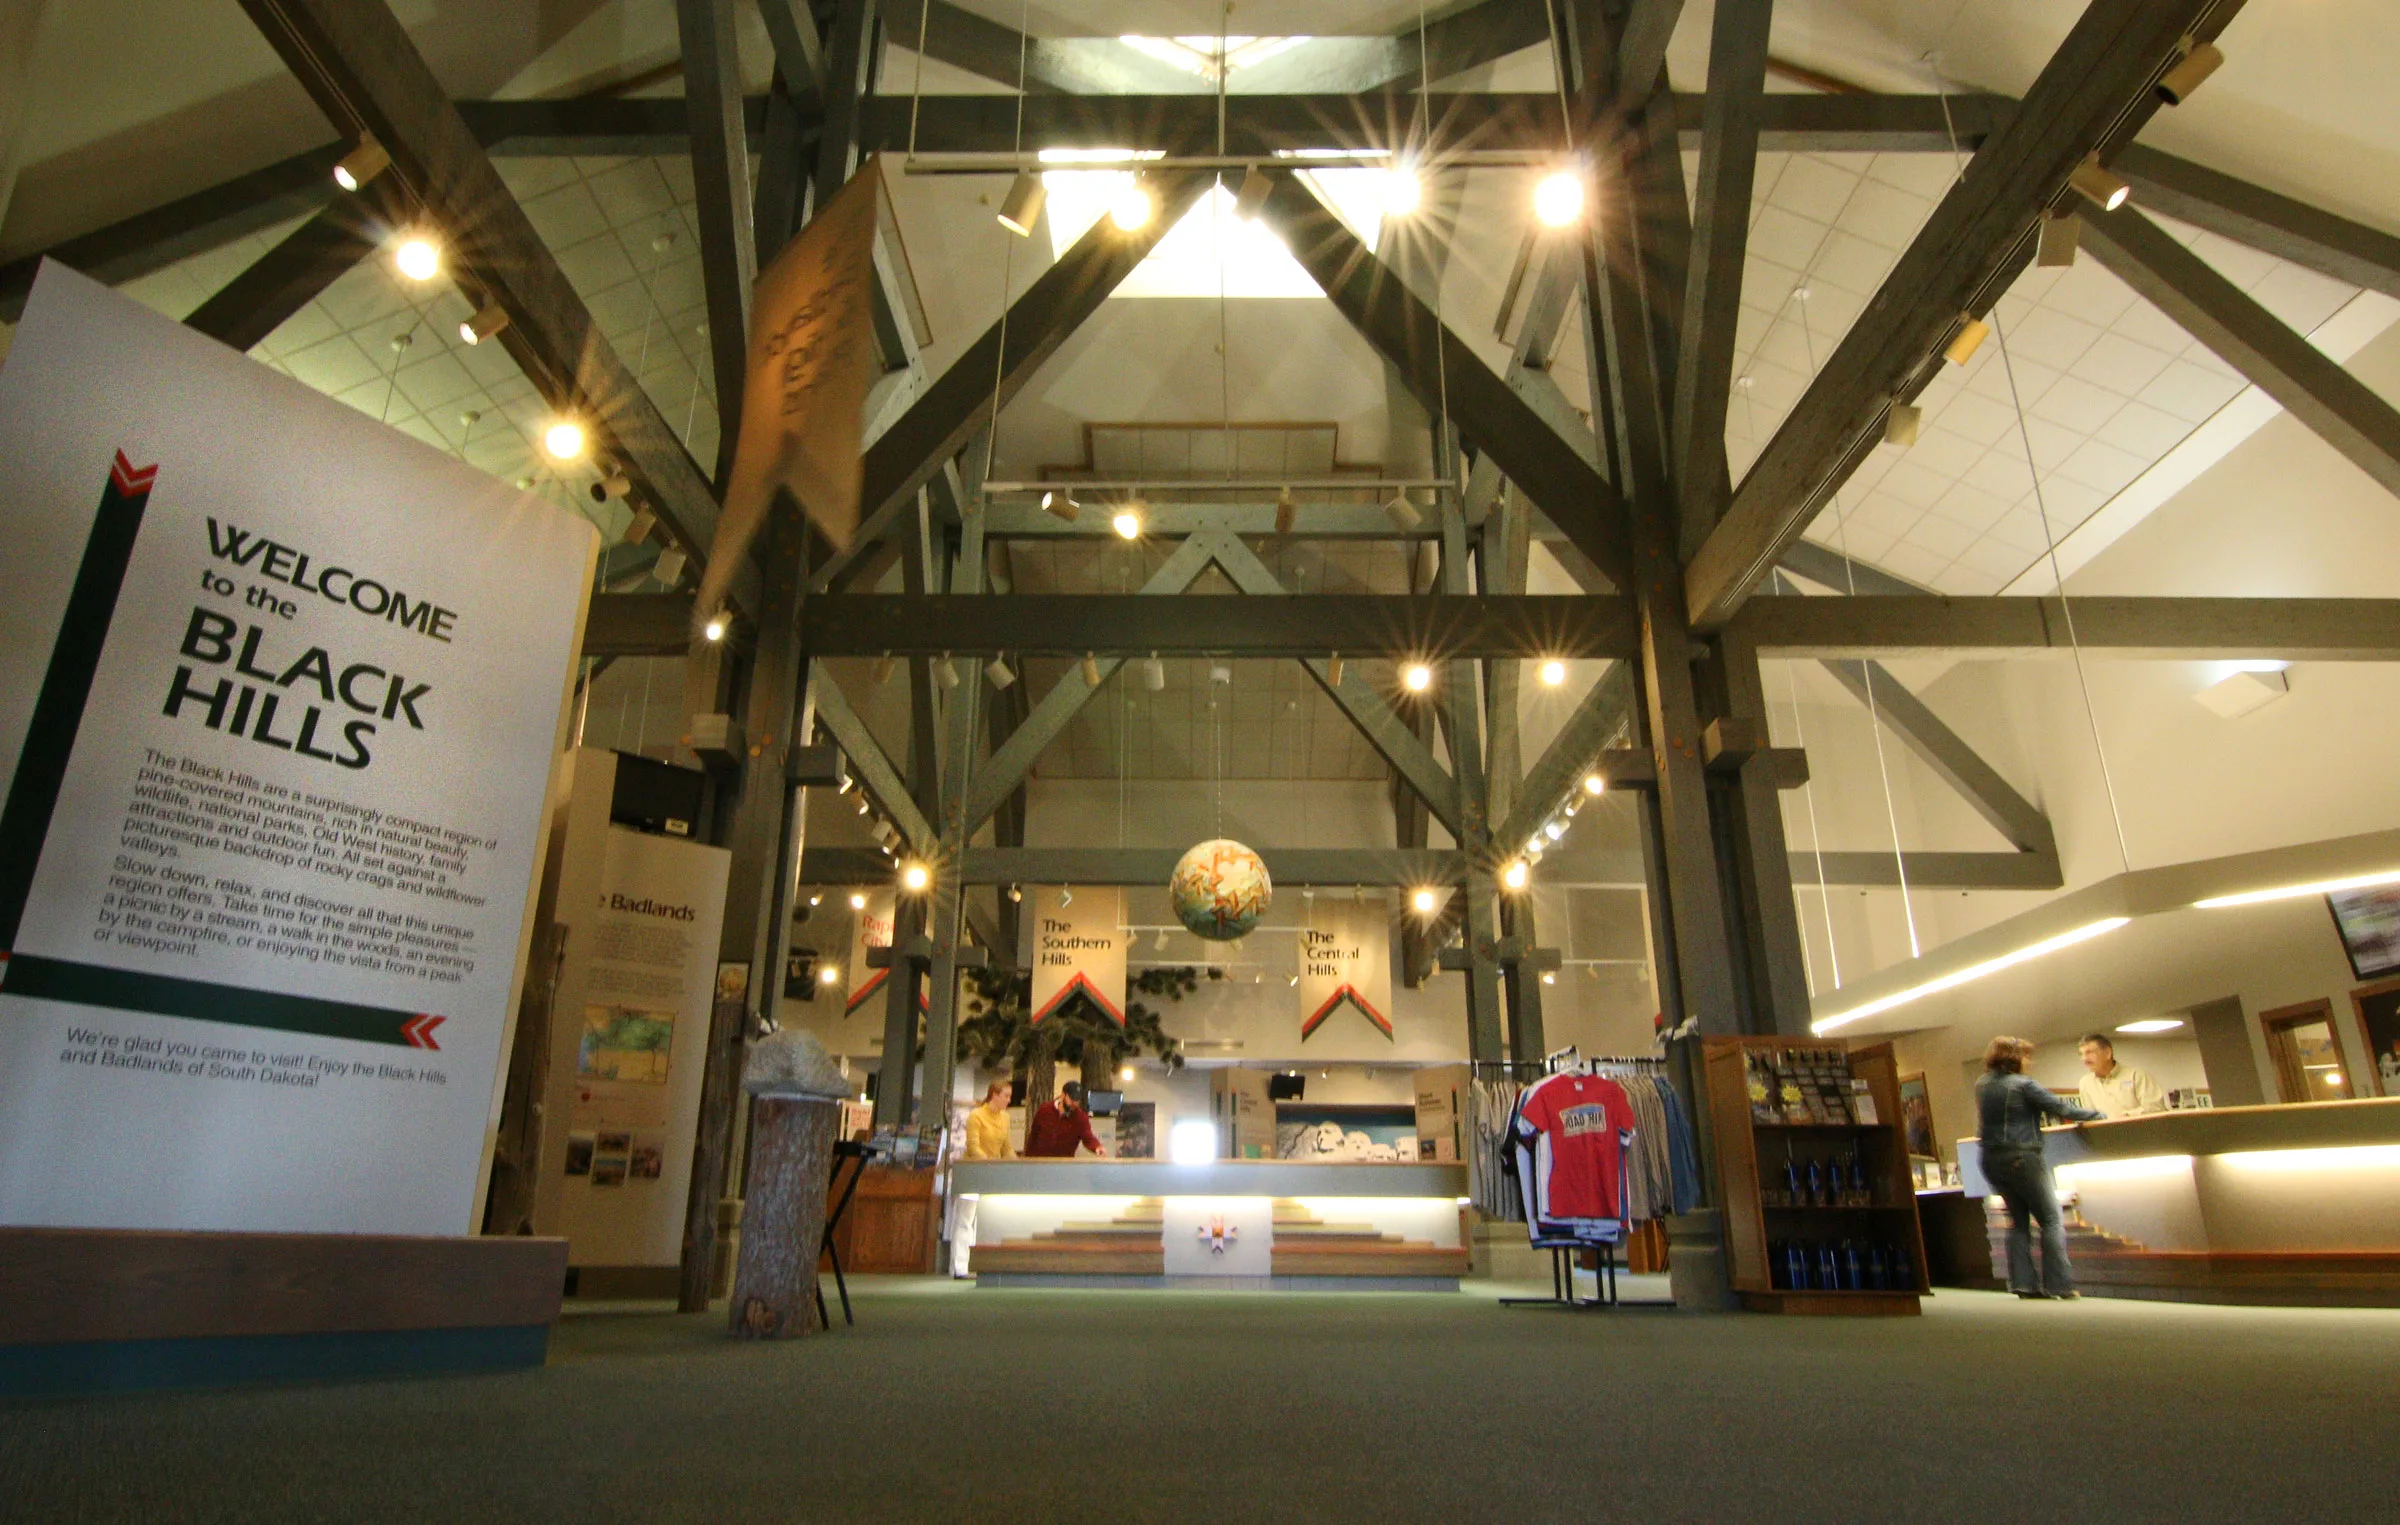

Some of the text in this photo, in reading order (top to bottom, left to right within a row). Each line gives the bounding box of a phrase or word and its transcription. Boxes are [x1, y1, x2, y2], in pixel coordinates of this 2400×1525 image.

[201, 567, 298, 621] to the
[206, 515, 459, 644] WELCOME
[179, 604, 432, 731] BLACK
[162, 664, 377, 771] HILLS
[137, 768, 244, 803] pine-covered
[332, 815, 357, 831] rich
[360, 821, 372, 835] in
[376, 828, 421, 847] natural
[145, 749, 496, 851] The Black Hills are a surprisingly compact region of
[124, 817, 484, 906] picturesque backdrop of rocky crags and wildflower
[129, 800, 213, 830] attractions
[218, 822, 248, 838] and
[252, 830, 308, 851] outdoor
[342, 848, 360, 863] All
[363, 855, 384, 868] set
[387, 861, 435, 880] against
[438, 873, 445, 882] a
[199, 800, 260, 824] national
[312, 825, 338, 842] Old
[341, 832, 377, 851] West
[429, 853, 466, 876] family
[110, 876, 162, 895] region
[222, 894, 258, 913] Take
[263, 902, 294, 920] time
[299, 909, 317, 924] for
[322, 913, 344, 929] the
[348, 920, 392, 940] simple
[395, 929, 458, 950] pleasures
[114, 856, 155, 876] Slow
[261, 888, 290, 903] and
[294, 892, 353, 915] discover
[357, 906, 373, 919] all
[376, 908, 401, 925] that
[405, 914, 427, 930] this
[432, 922, 473, 939] unique
[610, 893, 696, 922] Badlands
[862, 914, 895, 934] Rapi
[1042, 918, 1072, 933] The
[93, 928, 110, 940] or
[99, 907, 119, 928] by
[125, 912, 151, 929] the
[236, 934, 252, 946] or
[257, 937, 319, 961] enjoying
[323, 946, 345, 961] the
[349, 952, 381, 967] vista
[385, 957, 415, 973] from
[419, 965, 427, 975] a
[430, 967, 462, 981] peak
[104, 893, 114, 904] a
[118, 894, 166, 913] picnic
[170, 901, 189, 922] by
[193, 909, 203, 920] a
[268, 922, 277, 933] a
[281, 925, 313, 939] walk
[317, 928, 328, 942] in
[332, 931, 353, 947] the
[407, 948, 423, 959] an
[426, 951, 474, 971] evening
[1041, 951, 1073, 967] Hills
[1042, 935, 1112, 950] Southern
[1306, 946, 1360, 961] Central
[1307, 930, 1335, 945] The
[1307, 962, 1338, 977] Hills
[60, 1048, 319, 1085] and Badlands of South Dakota!
[65, 1027, 446, 1082] We're glad you came to visit! Enjoy the Black Hills
